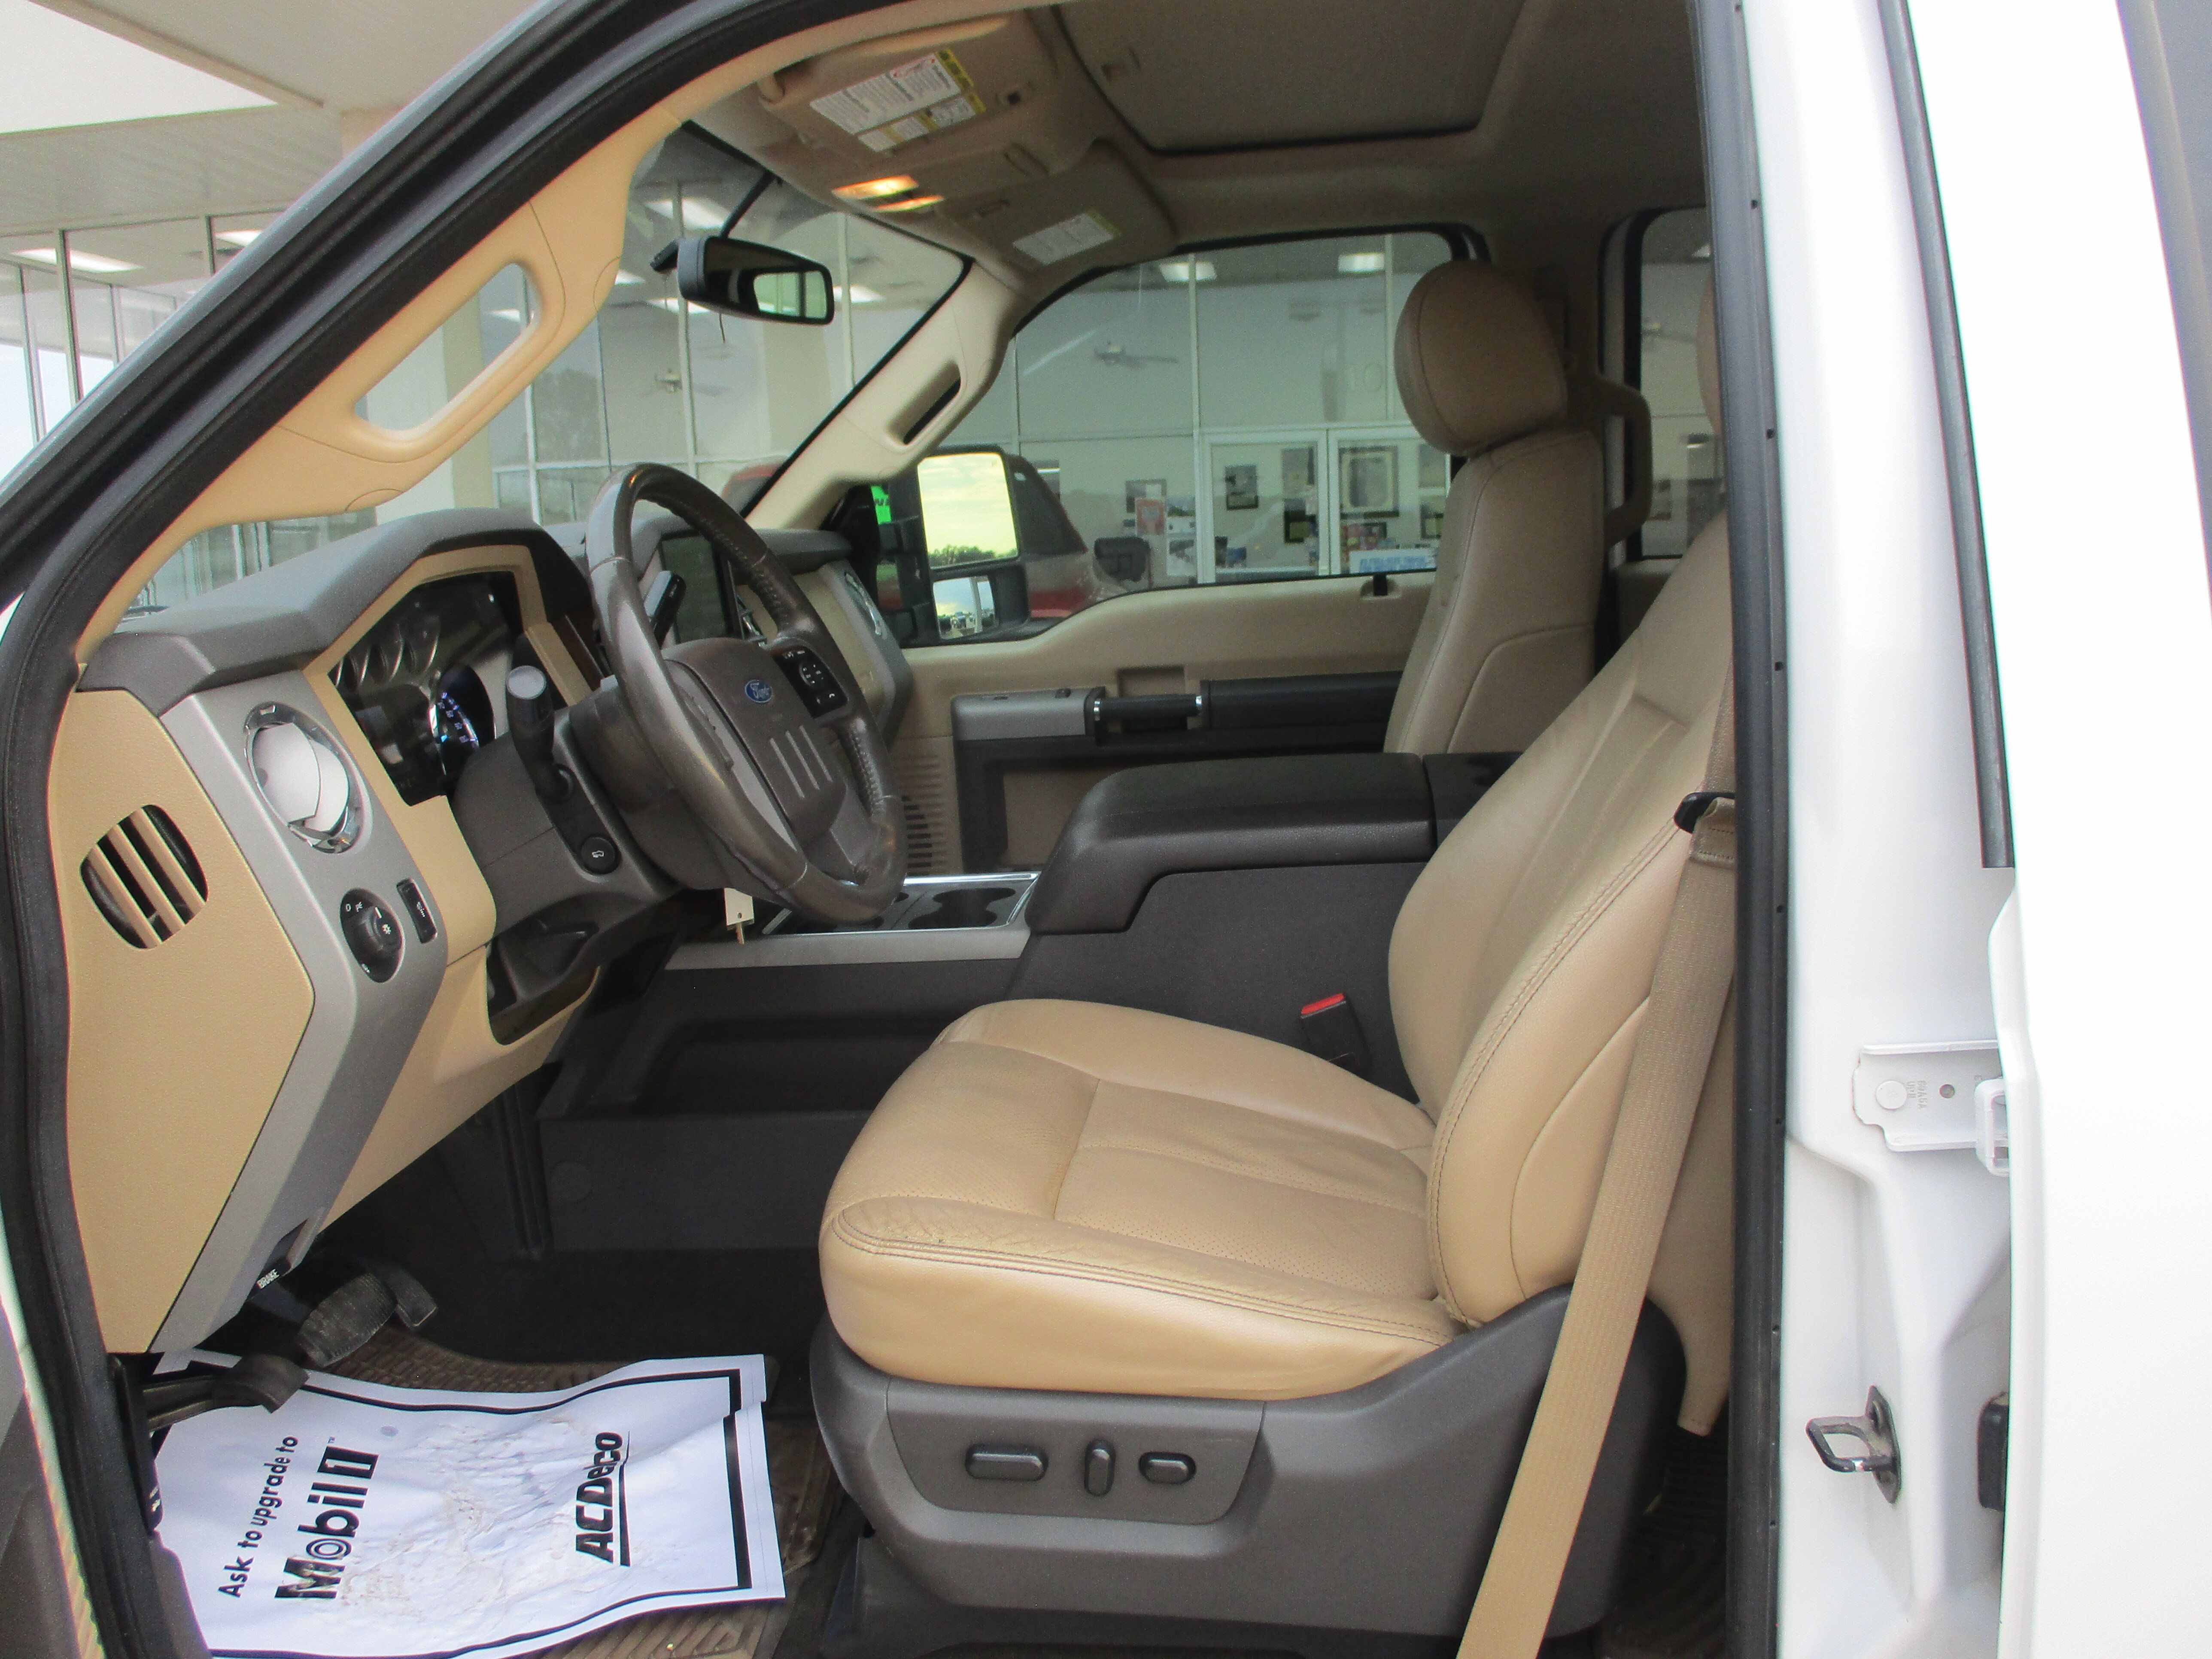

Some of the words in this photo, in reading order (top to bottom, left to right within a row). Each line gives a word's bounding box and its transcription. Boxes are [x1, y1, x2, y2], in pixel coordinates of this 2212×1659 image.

[749, 682, 771, 700] Ford
[218, 1555, 254, 1598] Ask
[237, 1530, 263, 1548] to
[250, 1456, 292, 1526] upgrade
[275, 1436, 299, 1453] to
[275, 1482, 368, 1599] Mobil
